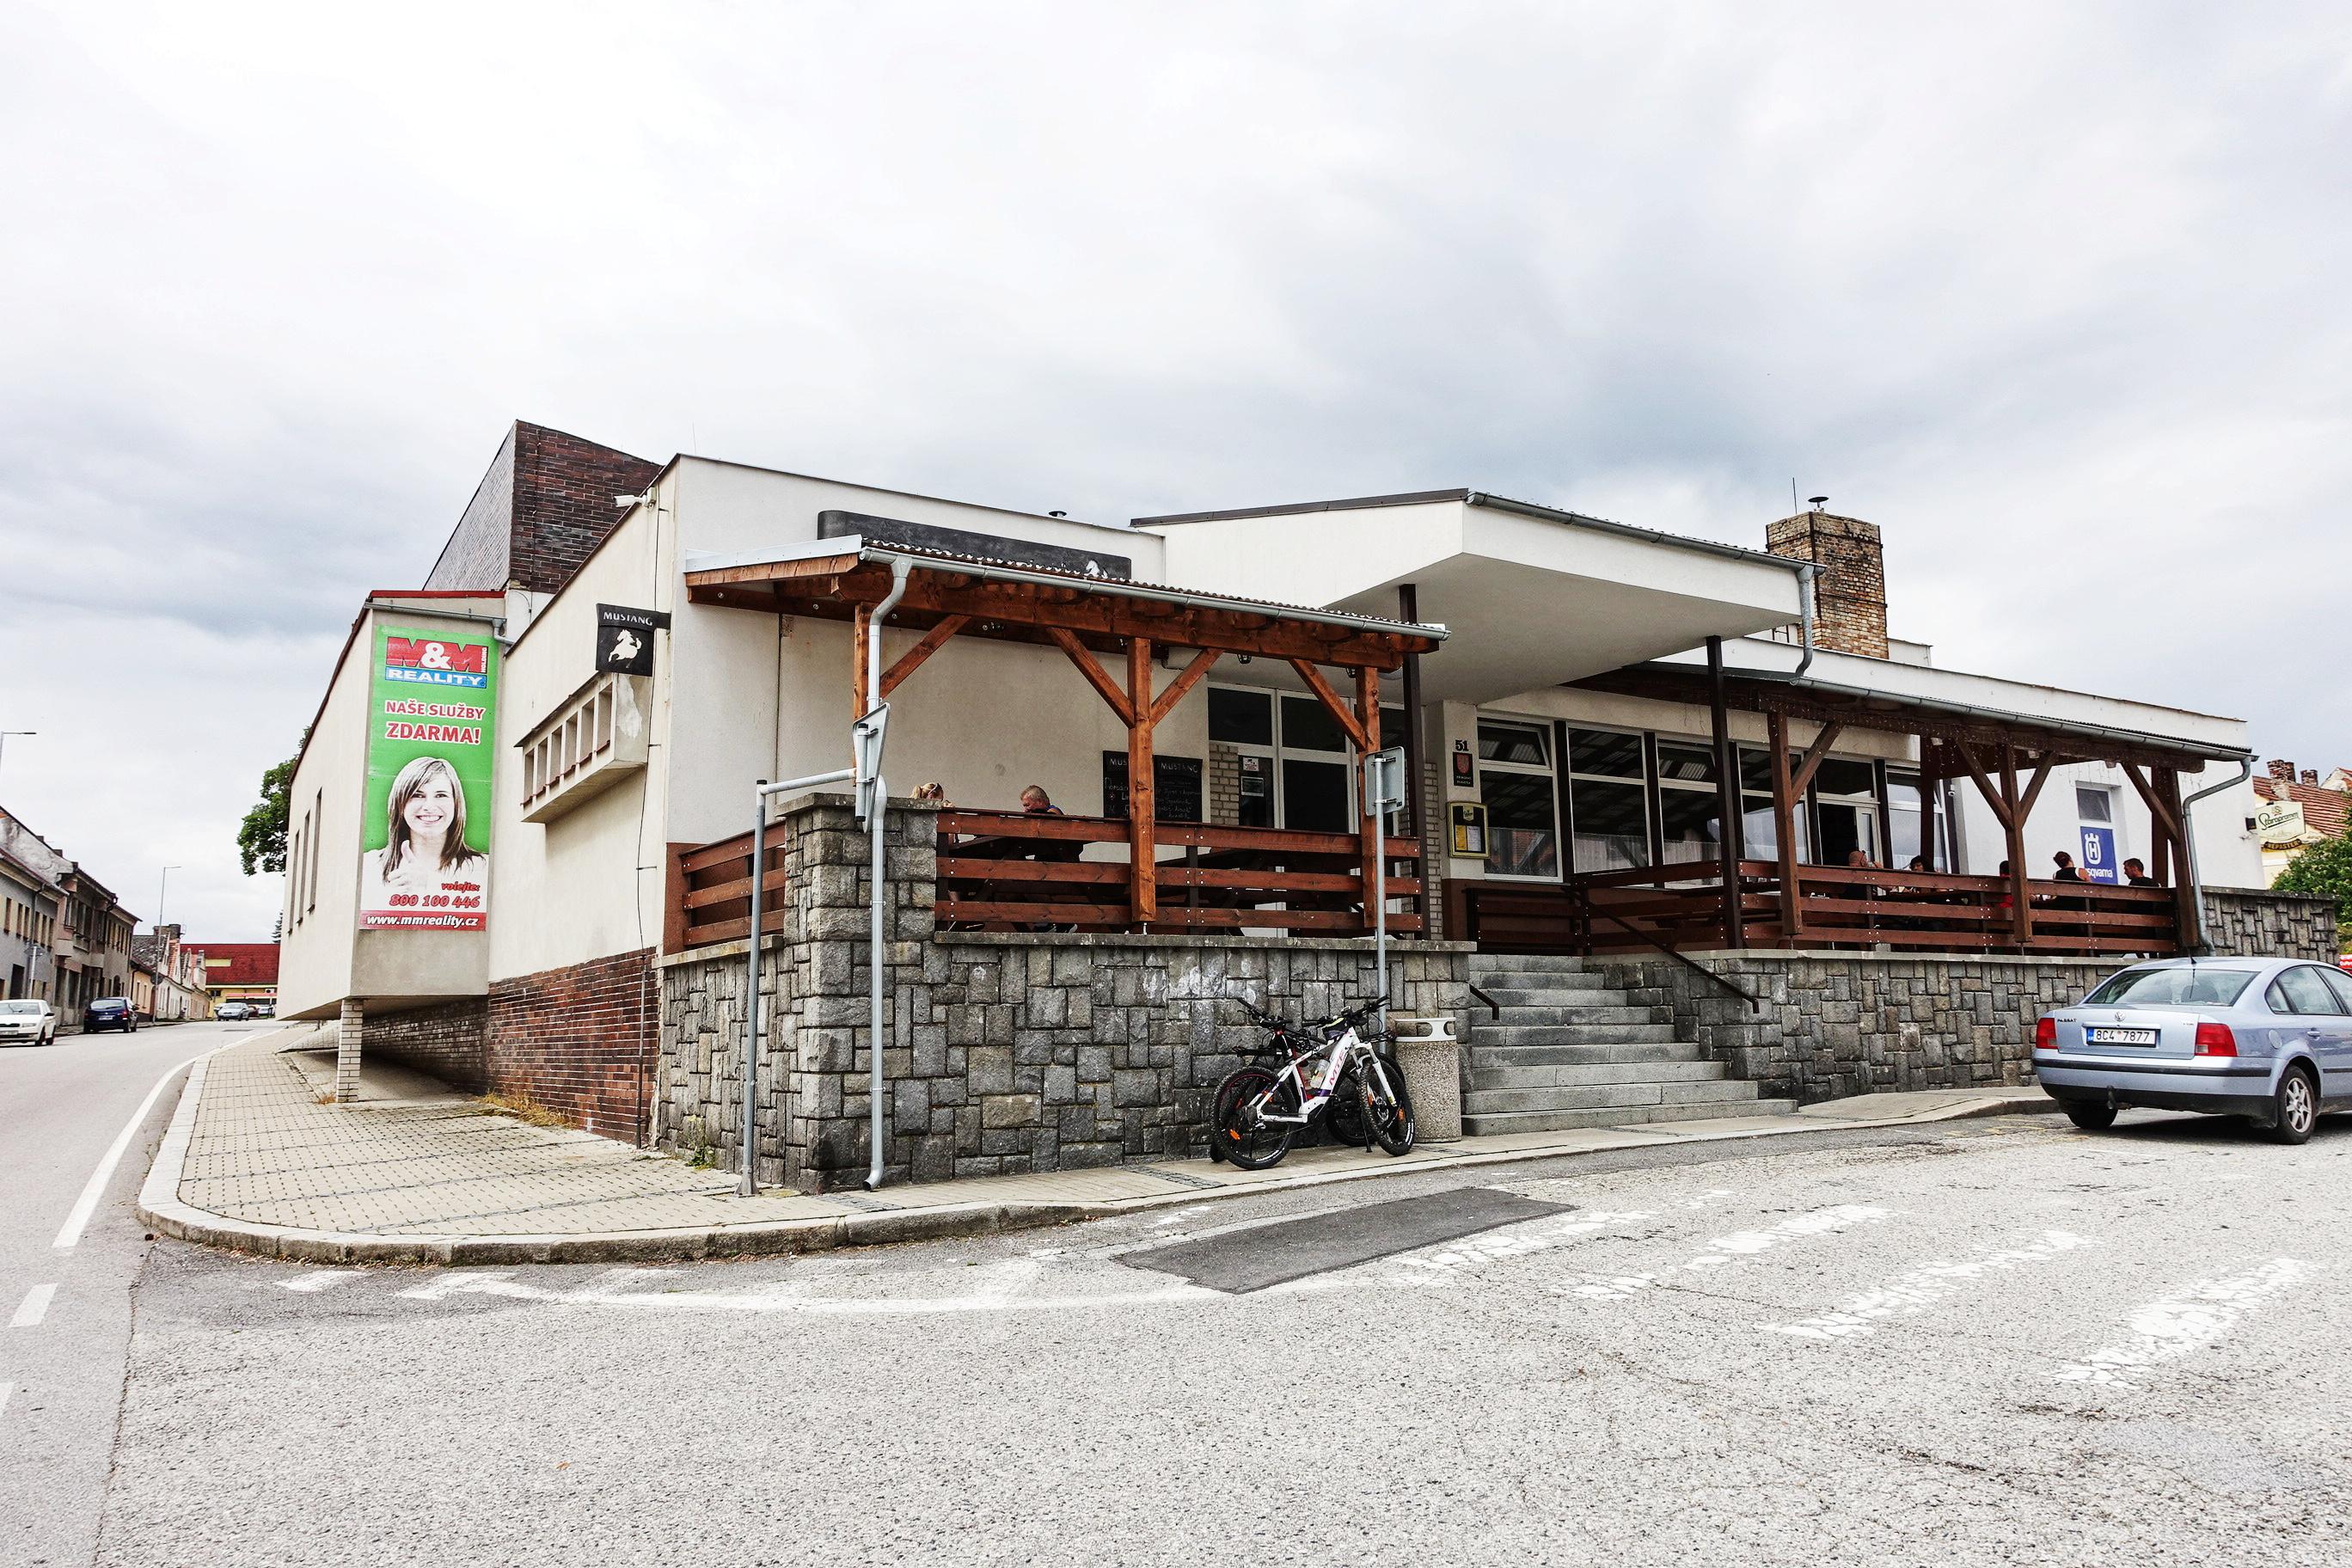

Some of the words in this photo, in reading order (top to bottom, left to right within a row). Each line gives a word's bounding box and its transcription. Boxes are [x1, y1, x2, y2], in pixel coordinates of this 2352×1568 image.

[603, 611, 652, 626] MUSTANG
[386, 636, 484, 674] M&M
[388, 669, 482, 685] REALITY
[385, 699, 426, 715] NAŠE
[428, 703, 485, 720] SLUŽBY
[386, 722, 480, 744] ZDARMA!
[1455, 739, 1469, 751] 51
[441, 881, 480, 893] volejte:
[389, 894, 419, 906] 800
[422, 895, 450, 907] 100
[452, 896, 480, 908] 446
[366, 914, 479, 928] www.mmreality.cz
[2096, 1030, 2115, 1040] 8C4
[2122, 1031, 2150, 1043] 7877
